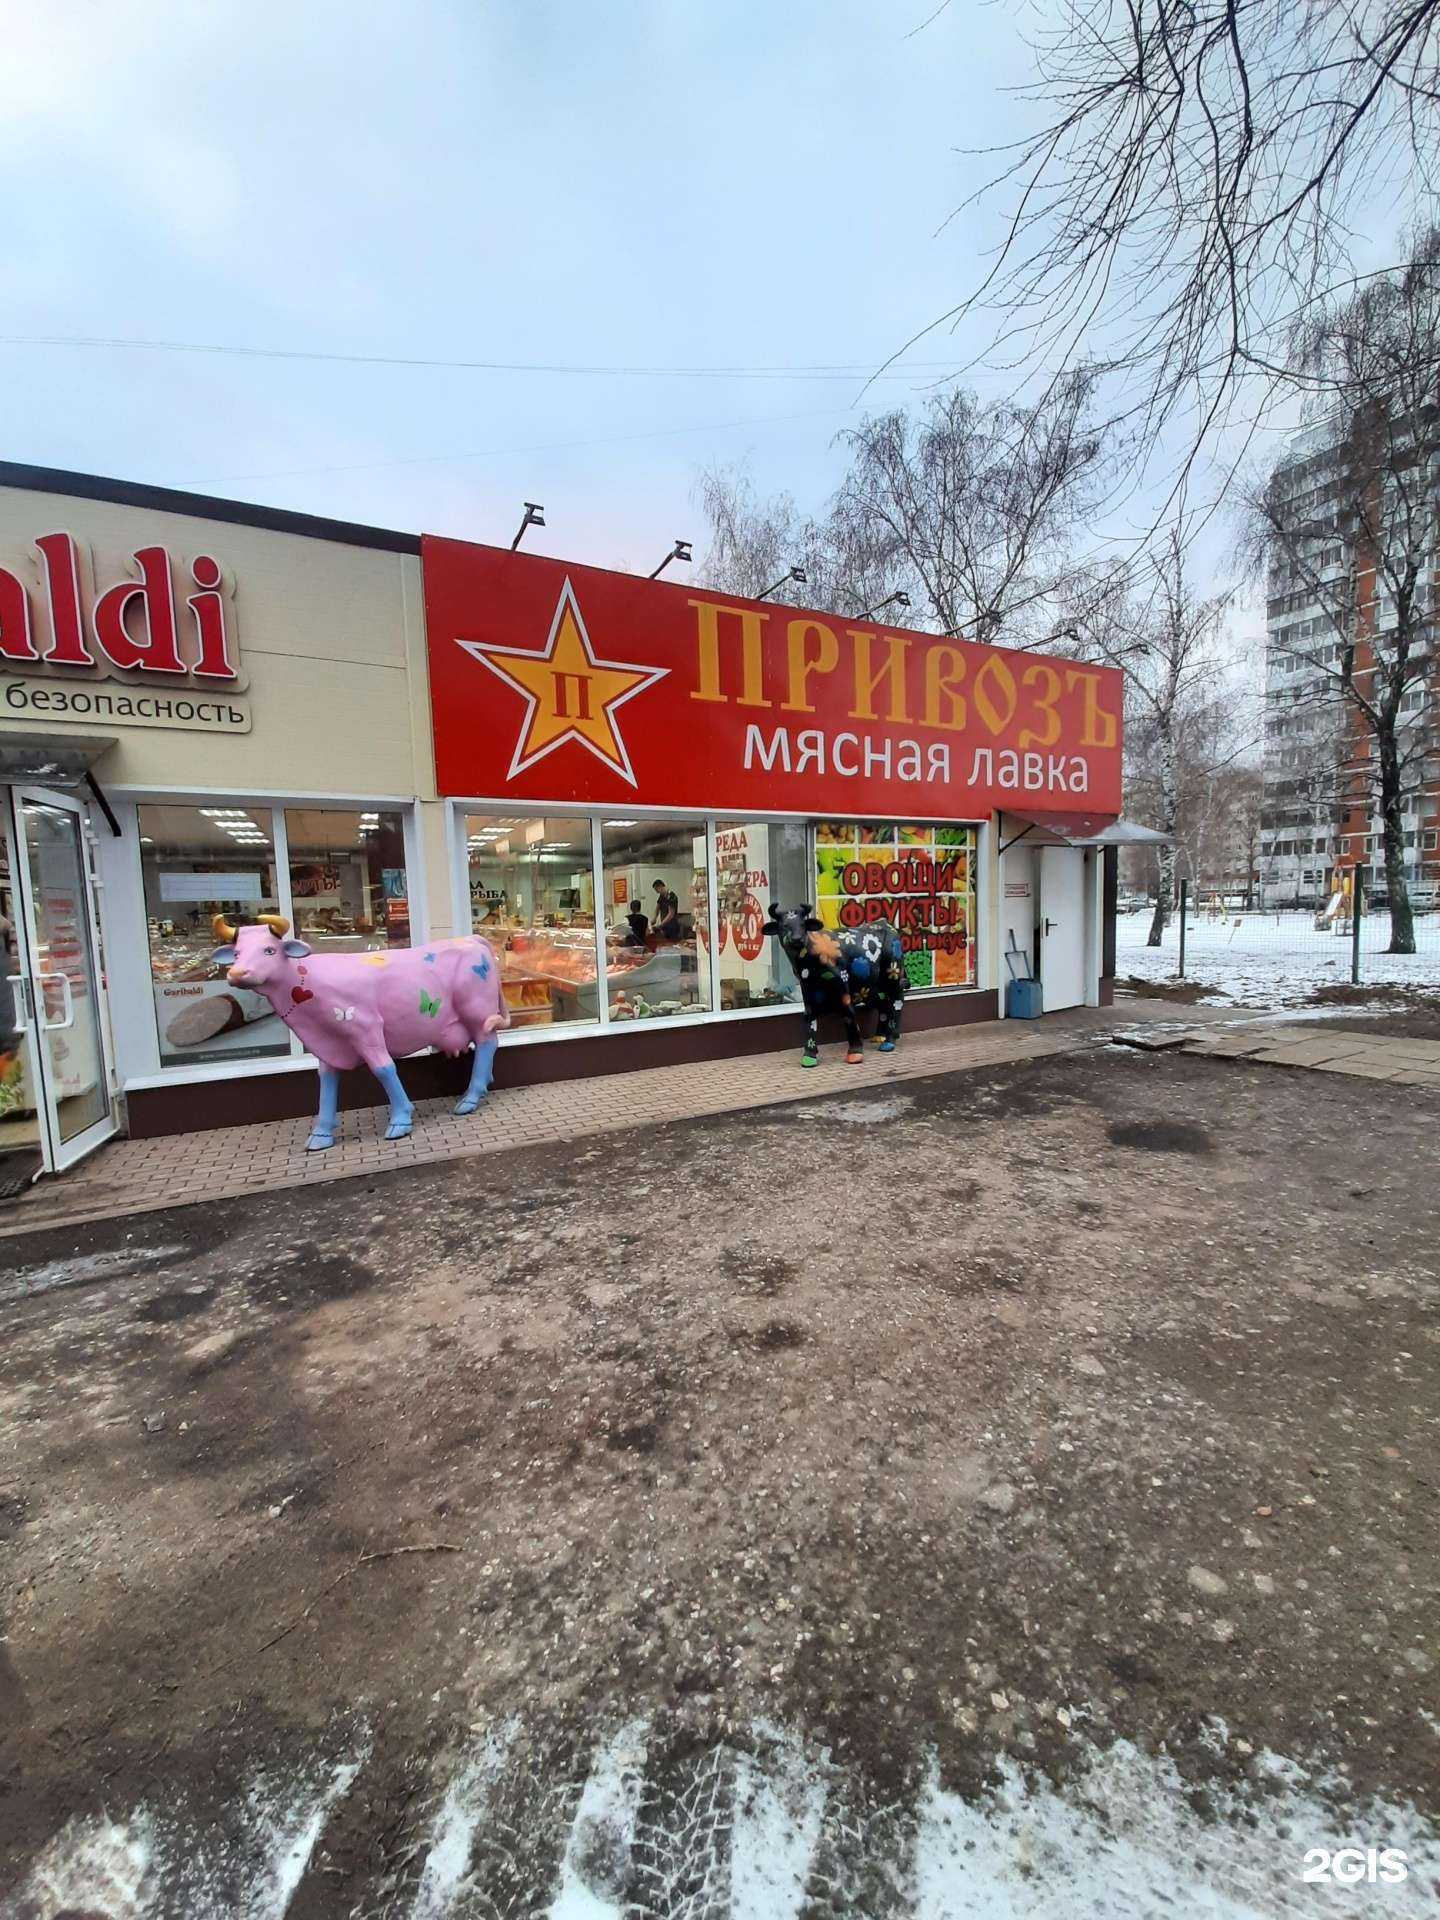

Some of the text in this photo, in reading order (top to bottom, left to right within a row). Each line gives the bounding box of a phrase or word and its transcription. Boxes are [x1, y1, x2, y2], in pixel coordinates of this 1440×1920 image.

[550, 671, 594, 720] П
[688, 599, 1118, 749] ПРИВОЗЪ
[5, 681, 245, 724] безопасность
[967, 747, 1089, 793] лавка
[470, 890, 508, 898] РЫБА
[842, 862, 954, 896] ОВОЩИ
[840, 896, 958, 927] ФРУКТЫ
